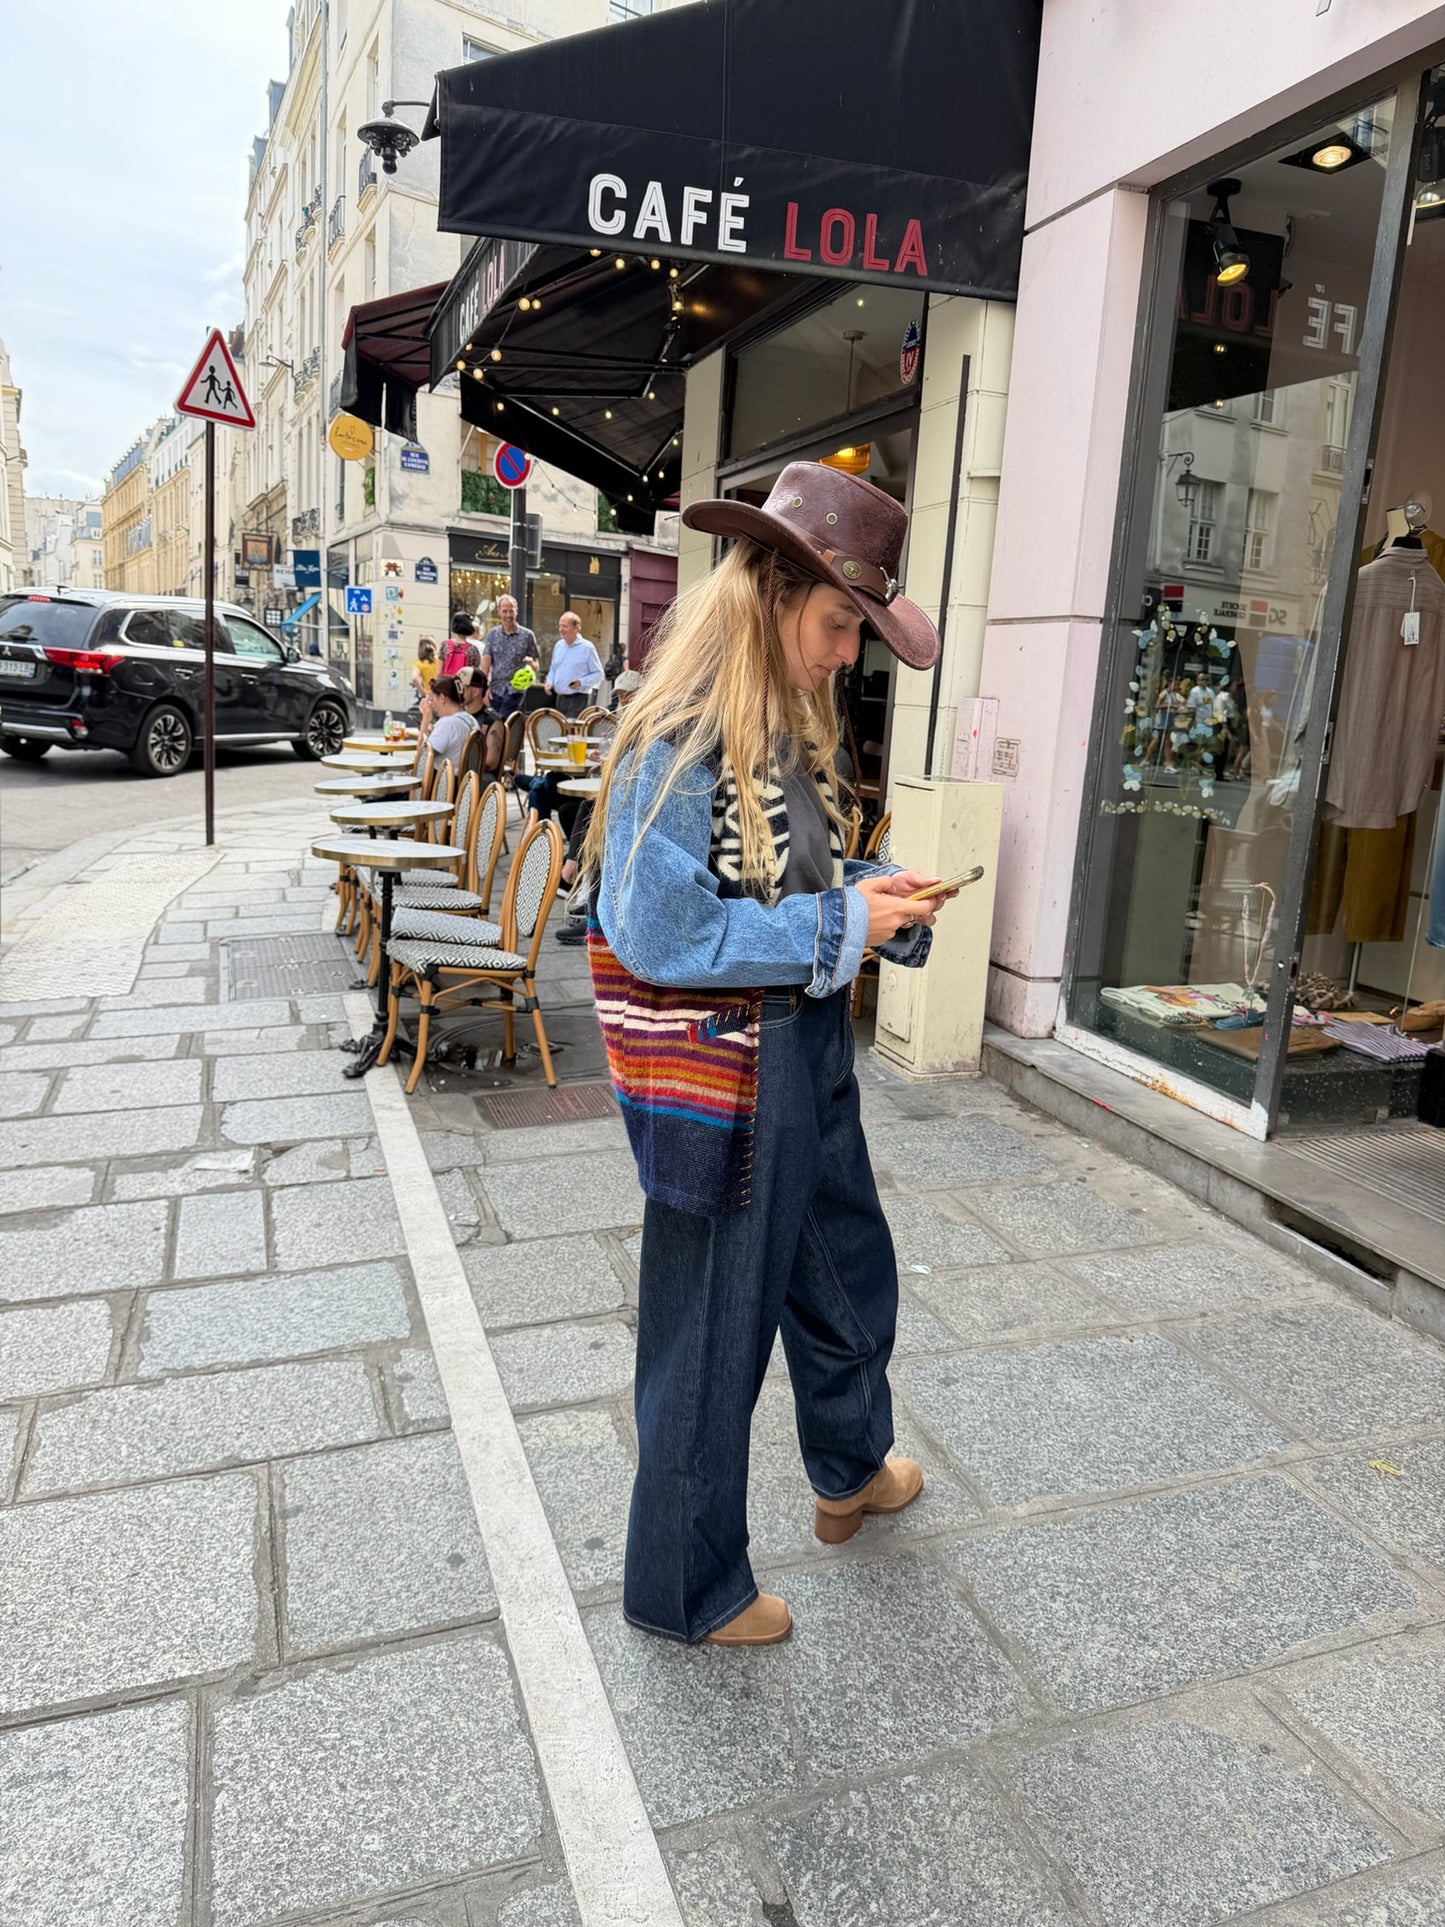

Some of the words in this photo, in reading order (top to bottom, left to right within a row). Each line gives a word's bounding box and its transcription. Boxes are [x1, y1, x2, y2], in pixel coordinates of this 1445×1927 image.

[588, 173, 750, 254] CAFÉ
[784, 201, 928, 276] LOLA
[459, 268, 480, 345] CAFÉ
[482, 244, 505, 314] LOLA
